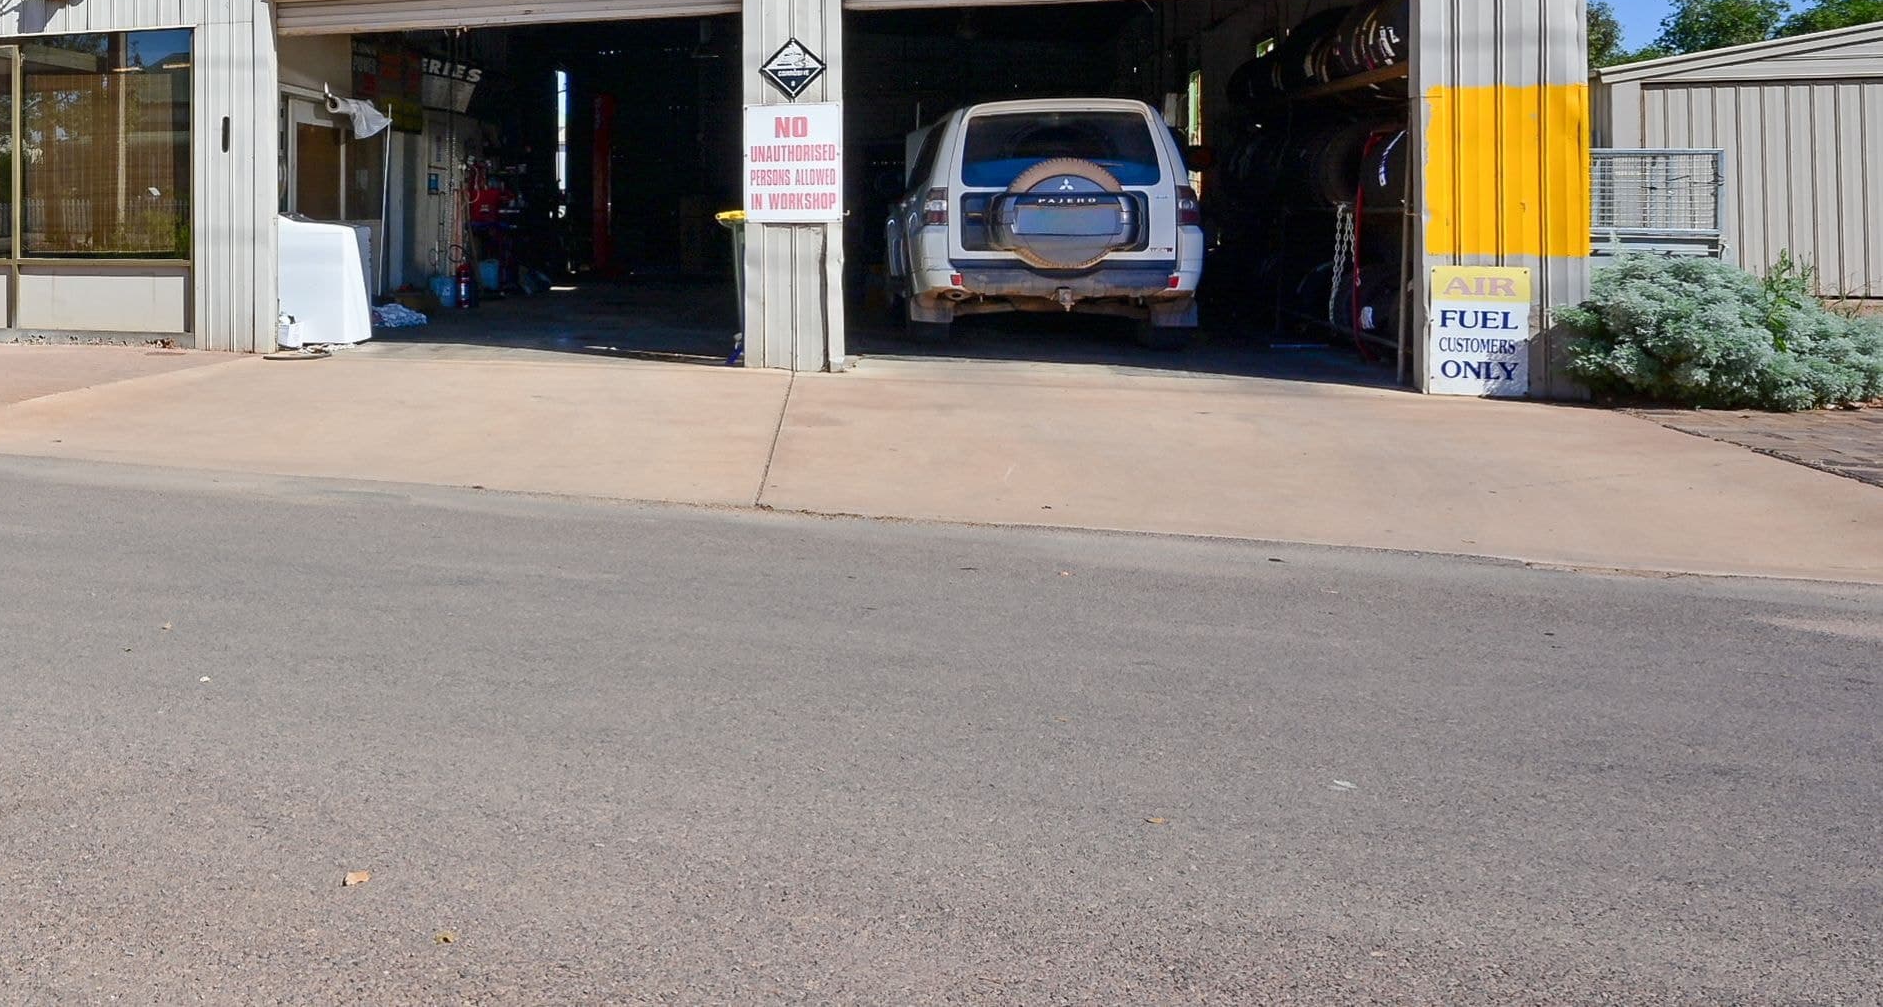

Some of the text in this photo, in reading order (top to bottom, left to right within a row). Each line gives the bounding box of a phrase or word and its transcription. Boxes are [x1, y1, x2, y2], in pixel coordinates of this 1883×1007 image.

[775, 116, 808, 139] NO
[750, 144, 836, 163] UNAUTHORISED
[750, 168, 836, 186] PERSONS ALLOWED
[751, 192, 836, 210] IN WORKSHOP
[1443, 276, 1516, 297] AIR
[1439, 309, 1519, 330] FUEL
[1439, 336, 1516, 355] CUSTOMERS
[1440, 359, 1519, 381] ONLY
